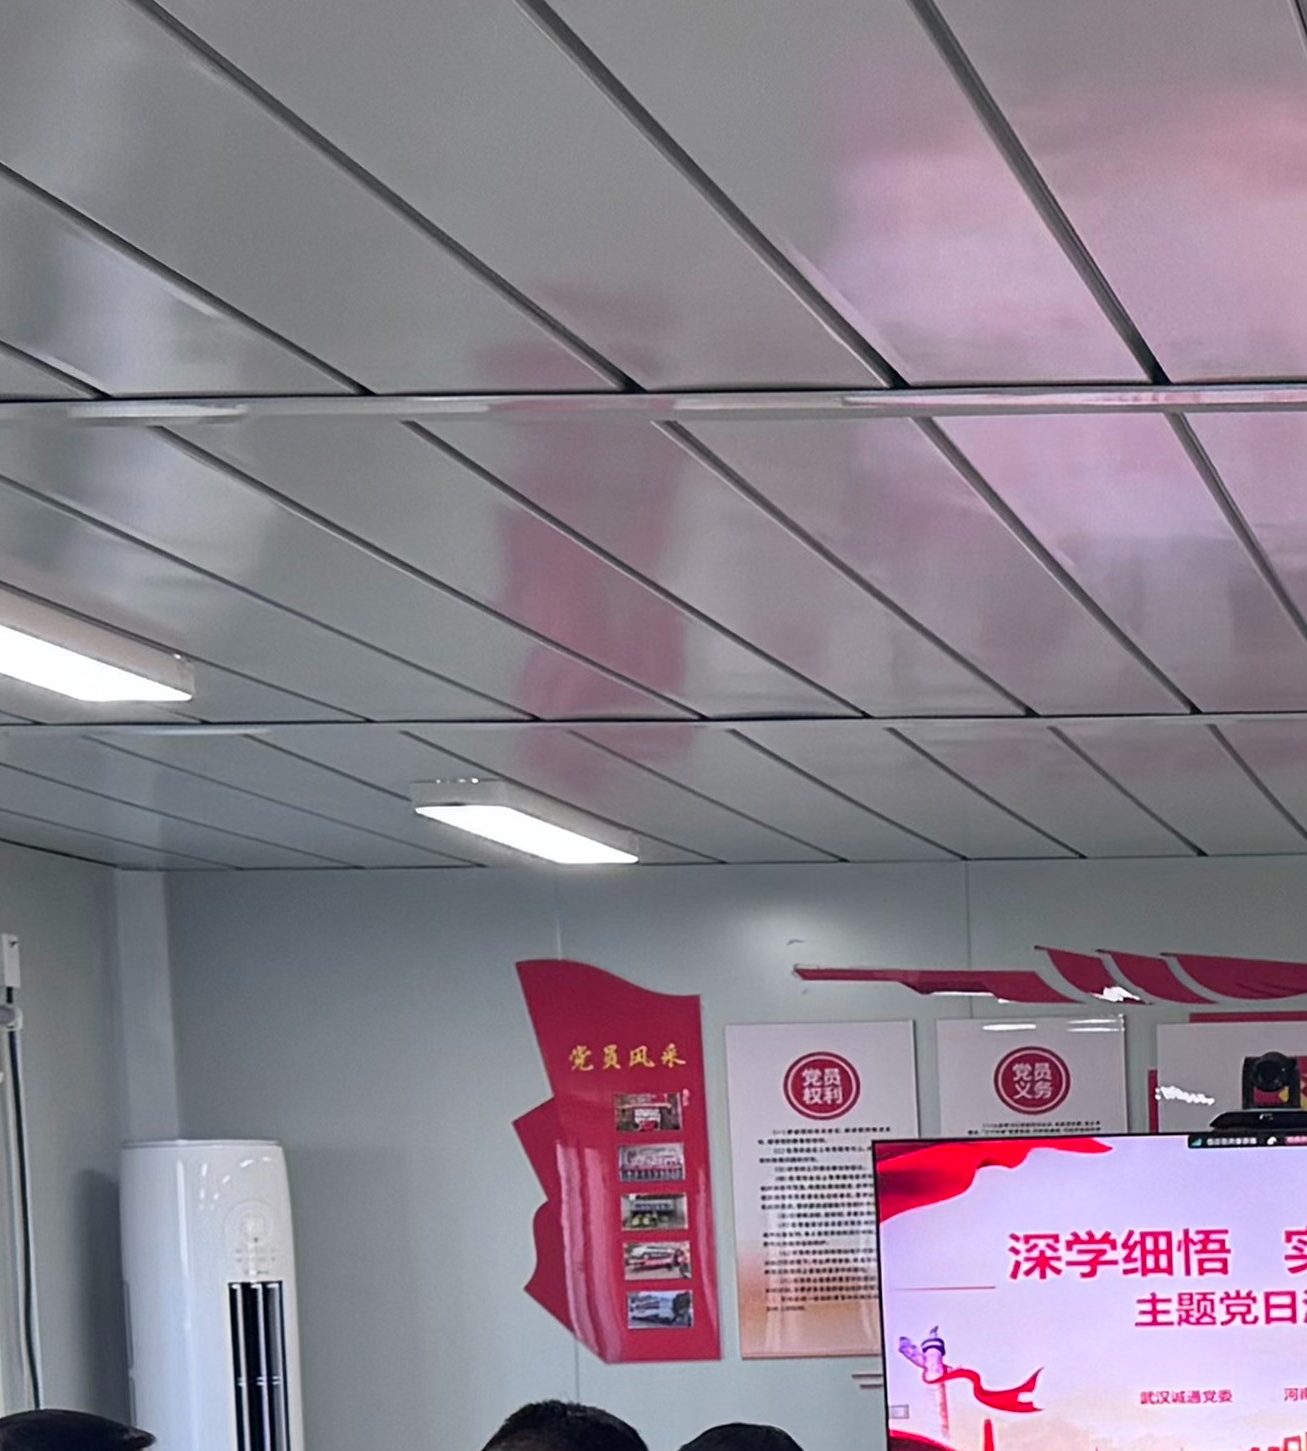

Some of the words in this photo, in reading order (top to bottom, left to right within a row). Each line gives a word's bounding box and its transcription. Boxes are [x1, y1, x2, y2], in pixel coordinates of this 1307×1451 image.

[570, 1043, 686, 1071] 党员风采
[802, 1067, 842, 1086] 党员
[1012, 1062, 1052, 1082] 党员
[802, 1087, 843, 1105] 权利
[1013, 1082, 1053, 1100] 义务
[1008, 1227, 1232, 1280] 深学细悟
